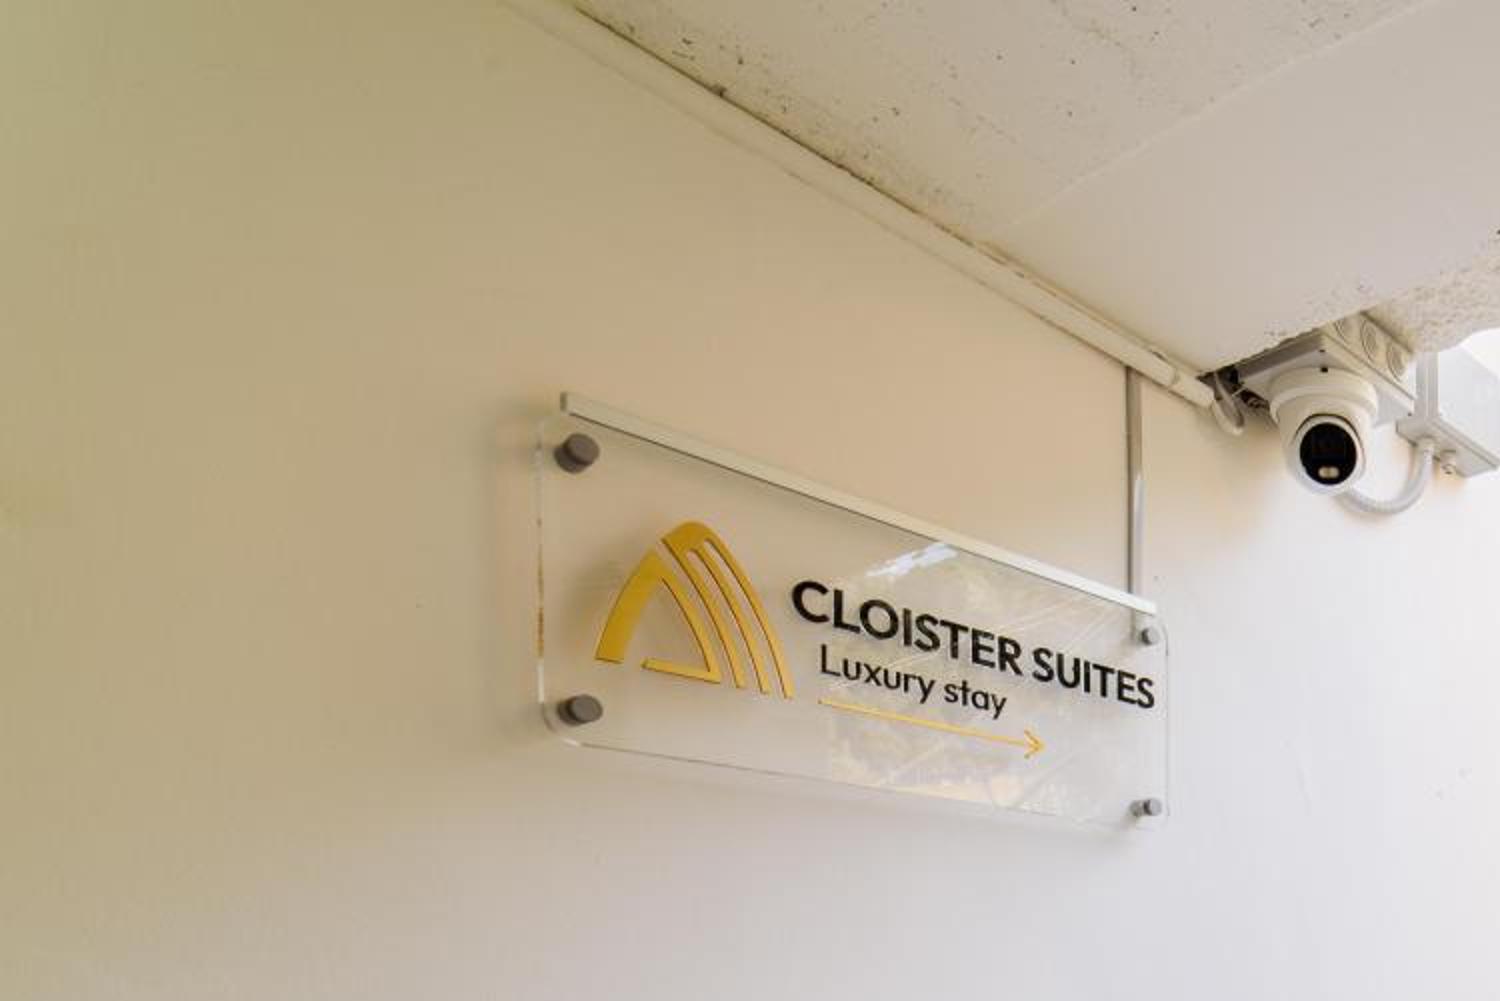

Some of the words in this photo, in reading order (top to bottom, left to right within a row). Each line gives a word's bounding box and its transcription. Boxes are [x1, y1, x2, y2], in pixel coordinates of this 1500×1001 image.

[790, 580, 1023, 676] CLOISTER
[1032, 647, 1155, 709] SUITES
[820, 643, 936, 704] Luxury
[943, 679, 1008, 720] stay
